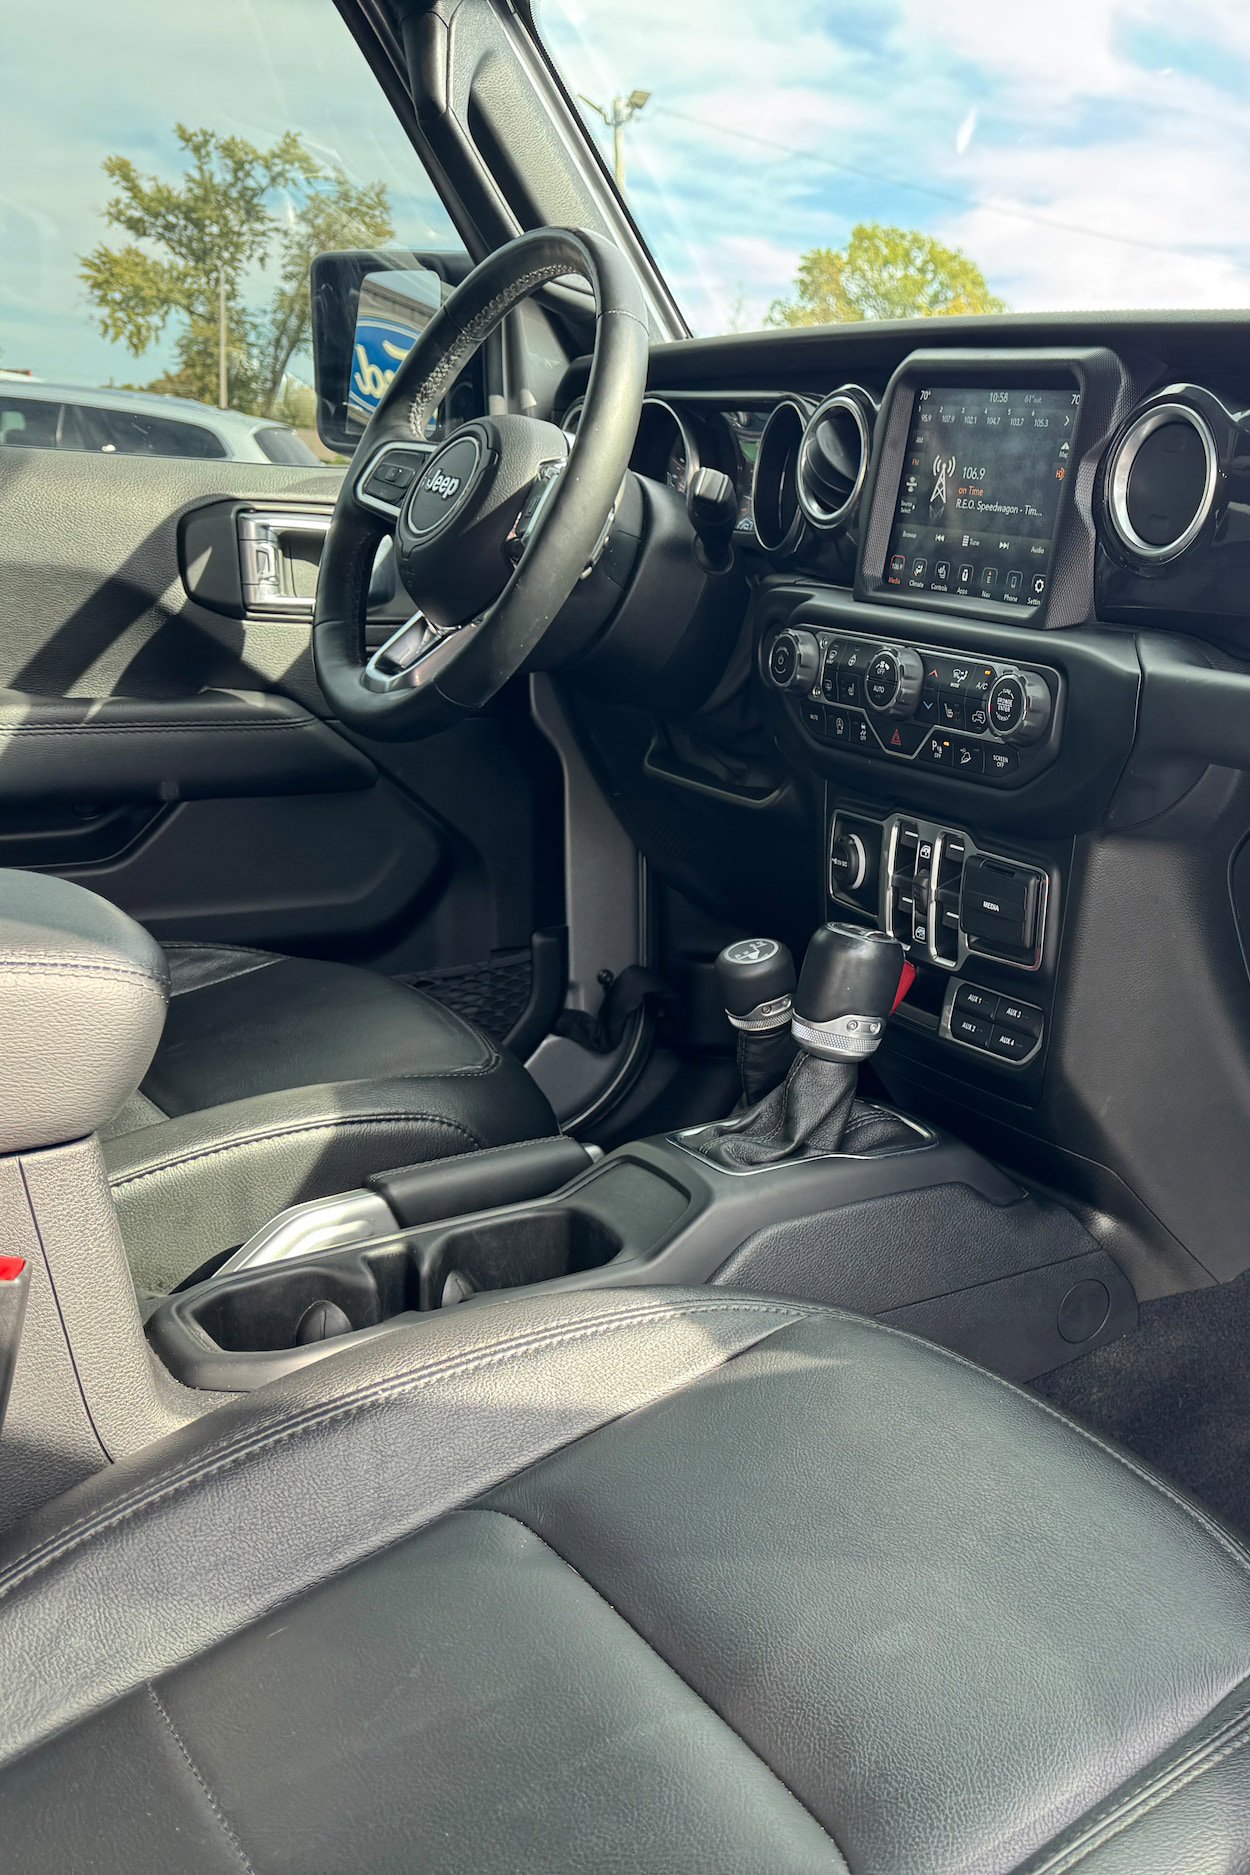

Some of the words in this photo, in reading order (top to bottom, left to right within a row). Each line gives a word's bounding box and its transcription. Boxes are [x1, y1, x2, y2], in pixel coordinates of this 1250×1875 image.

[990, 392, 1009, 403] 10:58
[962, 467, 986, 480] 106.9
[425, 468, 459, 499] Jeep
[958, 487, 967, 496] on
[968, 485, 984, 497] Time
[956, 498, 975, 510] R.E.O.
[977, 500, 1018, 516] Speedwagon
[1030, 546, 1045, 554] Audio
[908, 580, 925, 589] Climate
[930, 583, 948, 592] Controls
[956, 587, 968, 595] Apps
[981, 590, 991, 598] Nav
[1003, 593, 1018, 603] Phone
[876, 668, 886, 676] OFF
[873, 685, 885, 694] AUTO
[976, 682, 989, 691] A/C
[993, 754, 1009, 764] SCREEN
[983, 900, 1000, 912] MEDIA
[967, 993, 979, 1004] AUX
[1006, 1007, 1018, 1018] AUX
[961, 1021, 973, 1032] AUX
[999, 1035, 1012, 1046] AUX
